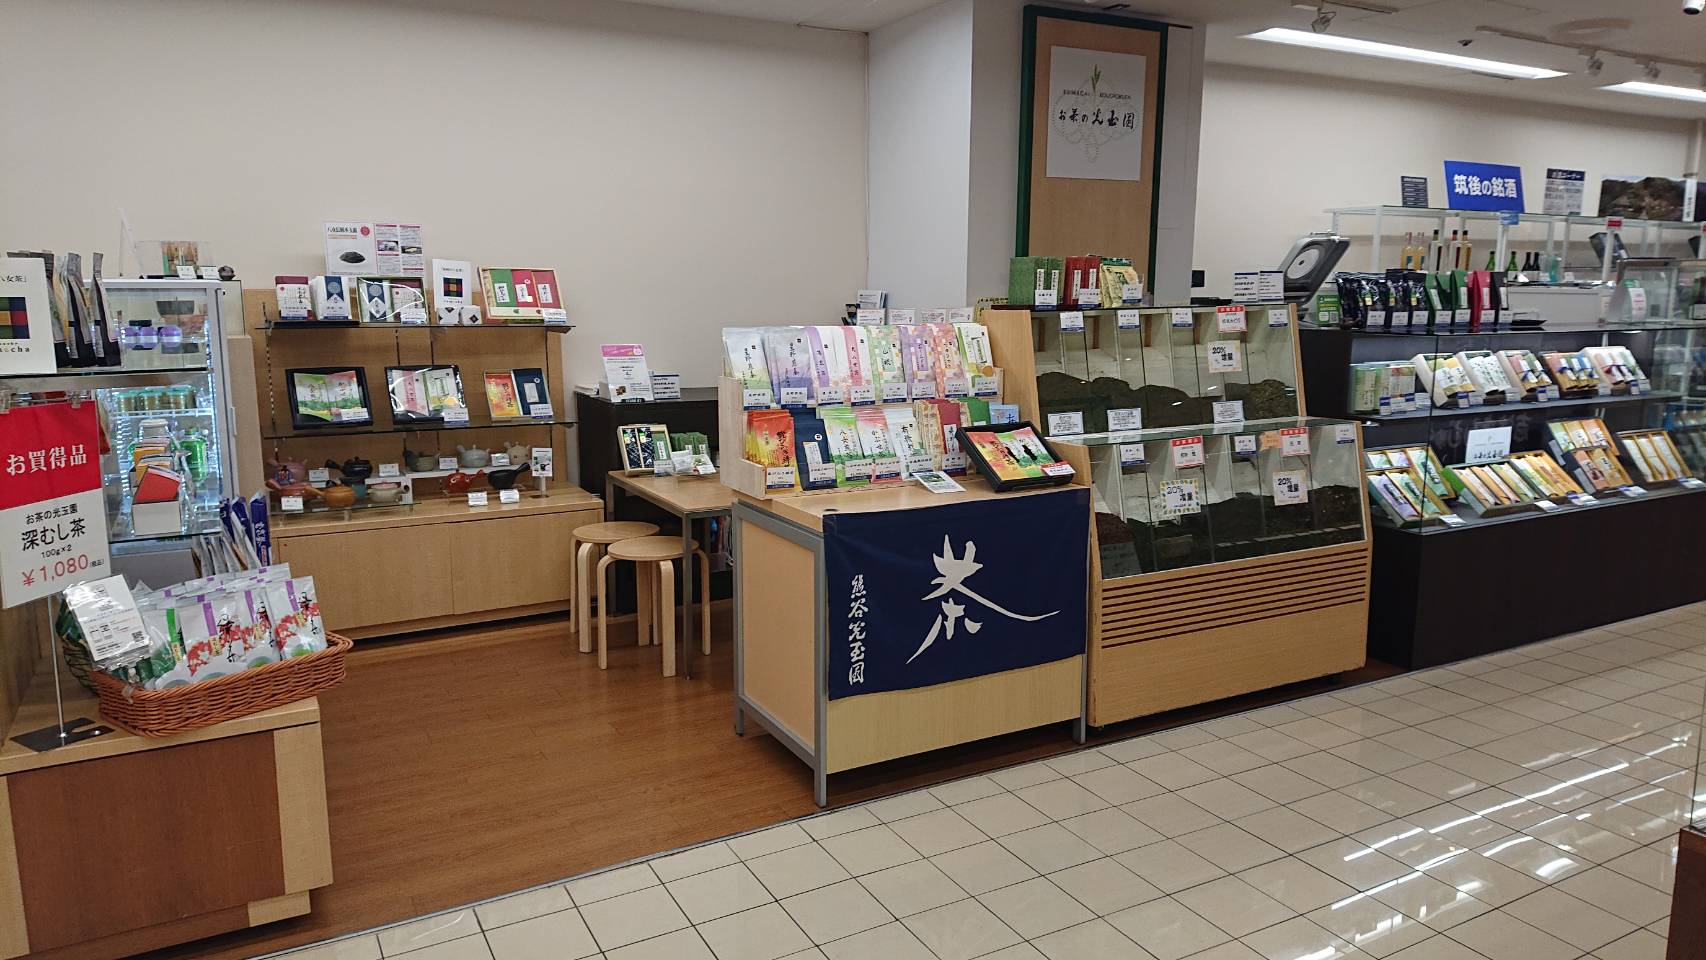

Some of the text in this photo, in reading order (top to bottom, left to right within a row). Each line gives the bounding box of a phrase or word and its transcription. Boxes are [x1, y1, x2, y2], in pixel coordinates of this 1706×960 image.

[1453, 174, 1517, 198] 筑後の銘酒
[6, 444, 88, 475] お買得品
[1166, 485, 1184, 495] 20%
[1277, 476, 1292, 486] 20%
[26, 502, 78, 525] お茶の光玉園
[21, 518, 86, 551] 深むし茶
[906, 534, 1061, 664] 茶
[848, 574, 868, 686] 熊谷光玉園
